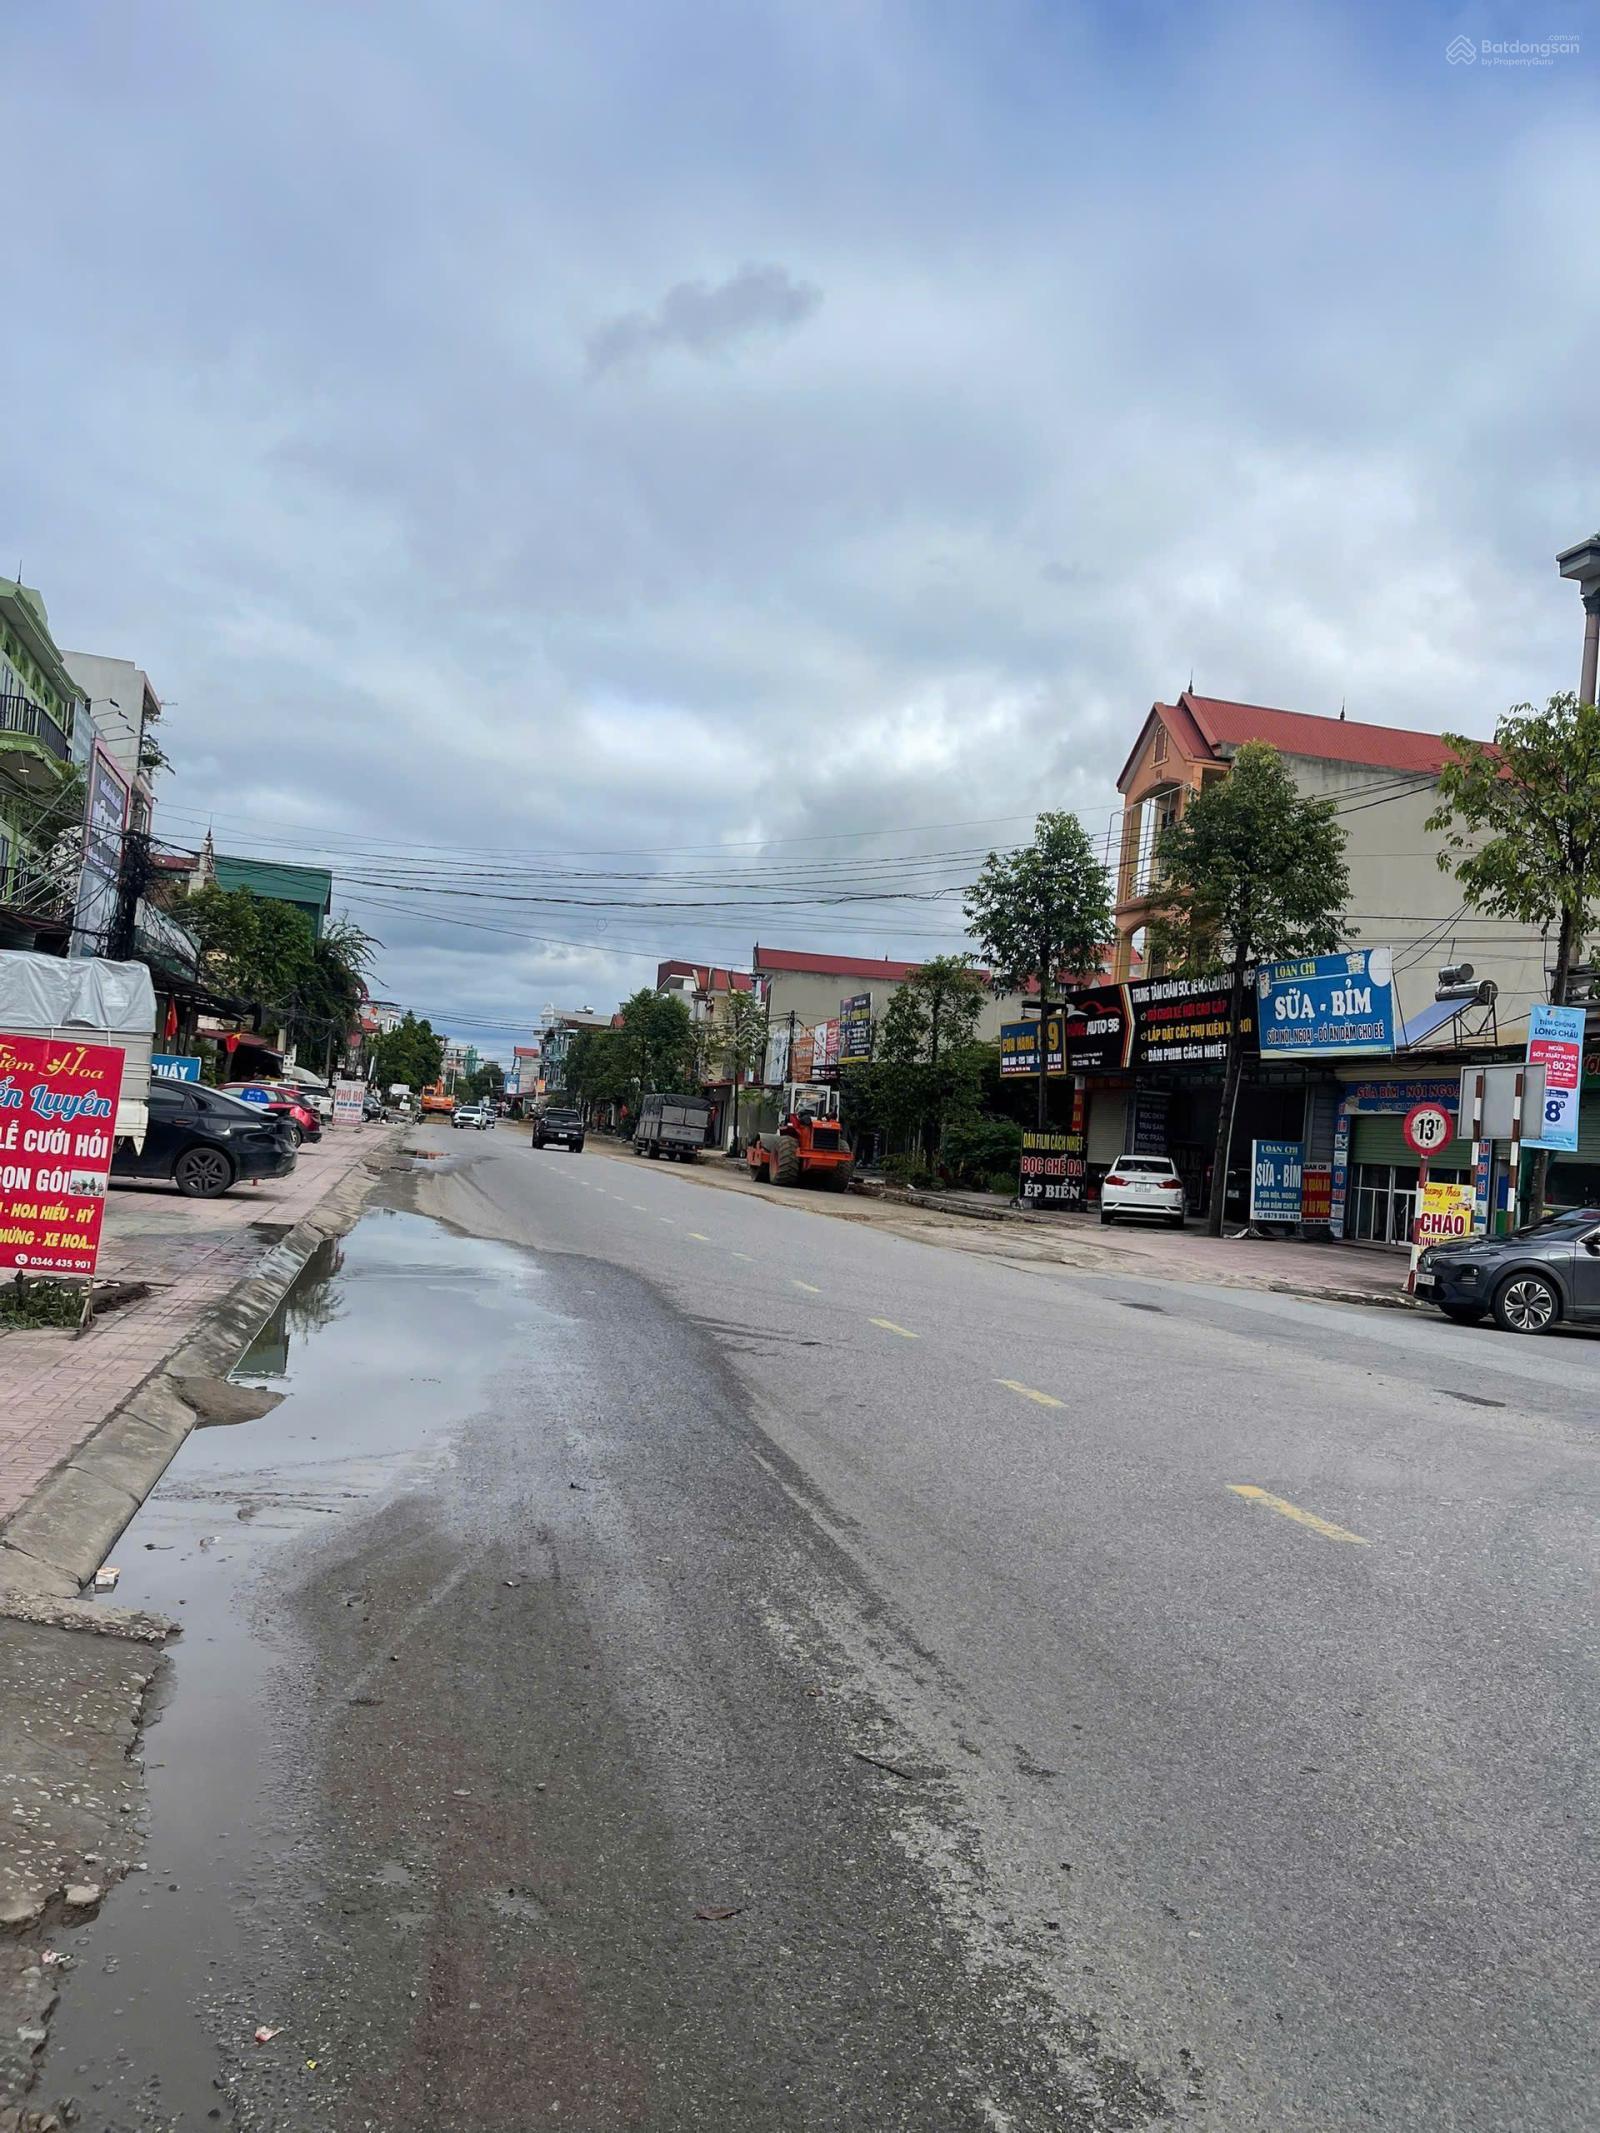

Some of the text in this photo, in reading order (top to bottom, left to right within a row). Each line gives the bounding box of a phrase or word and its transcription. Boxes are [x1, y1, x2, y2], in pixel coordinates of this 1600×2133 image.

[1275, 962, 1316, 979] LOAN CHI
[1275, 987, 1316, 1021] SỮA
[1331, 978, 1372, 1017] BỈM
[1086, 1019, 1107, 1036] AUTO
[1108, 1017, 1120, 1033] 98
[1175, 1023, 1189, 1039] CÁC
[1357, 1023, 1372, 1040] CHO
[1534, 1027, 1579, 1039] LONG CHÂU
[1183, 1043, 1202, 1060] CÁCH
[1204, 1040, 1227, 1060] NHIỆT
[38, 1046, 104, 1080] Hoa
[30, 1084, 112, 1122] Luyên
[23, 1128, 71, 1156] CƯỚI
[75, 1128, 109, 1159] HỎI
[1261, 1144, 1298, 1154] LOAN CHI
[1021, 1153, 1083, 1178] BỌC GHẾ DA
[1255, 1158, 1275, 1188] SỮA
[1283, 1156, 1302, 1188] BỈM
[36, 1165, 70, 1193] GÓI
[1024, 1179, 1043, 1197] ÉP
[10, 1203, 38, 1219] HOA
[39, 1200, 69, 1221] HIẾU
[76, 1204, 96, 1224] HỶ
[42, 1232, 61, 1247] XE
[30, 1256, 91, 1270] 0346 435 901
